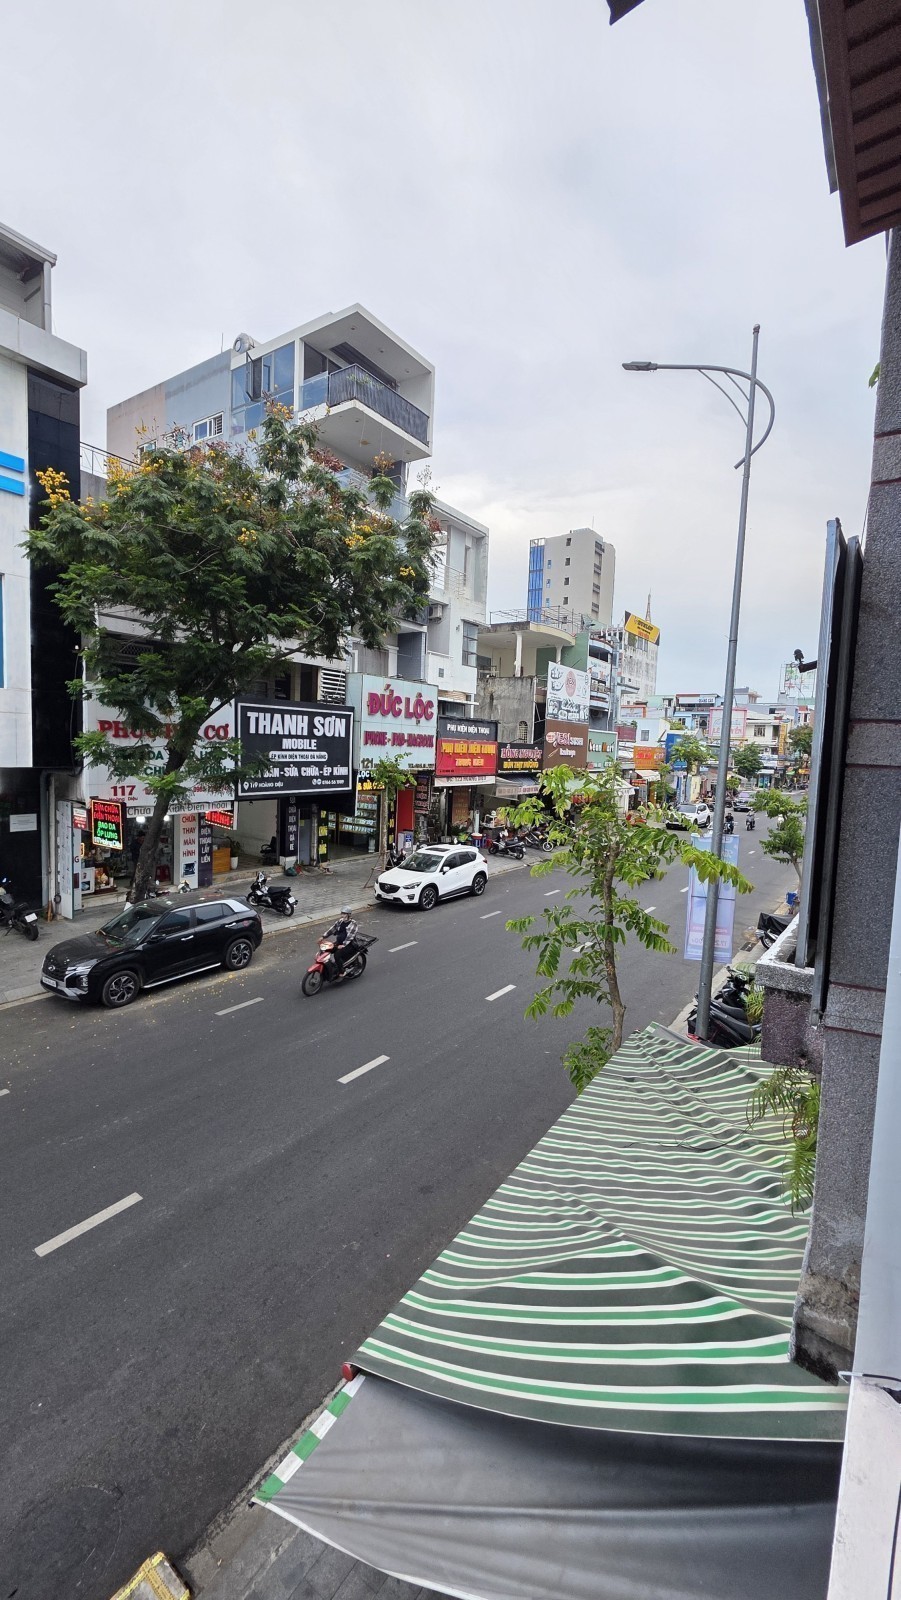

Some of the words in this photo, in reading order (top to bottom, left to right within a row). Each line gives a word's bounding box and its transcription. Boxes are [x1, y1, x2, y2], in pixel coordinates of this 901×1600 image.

[367, 684, 402, 717] ĐỨC
[405, 692, 434, 726] LỘC
[247, 712, 308, 736] THANH
[313, 716, 346, 738] SƠN
[446, 724, 456, 733] PHỤ
[458, 724, 467, 734] KIỆN
[468, 725, 477, 734] ĐIỆN
[282, 738, 317, 750] MOBILE
[364, 731, 387, 746] IPHONE
[111, 785, 136, 796] 117
[182, 812, 196, 823] CHỮA
[201, 827, 211, 835] ĐIỆN
[183, 838, 195, 846] MÀN
[200, 837, 212, 845] THOẠI
[183, 849, 196, 857] HÌNH
